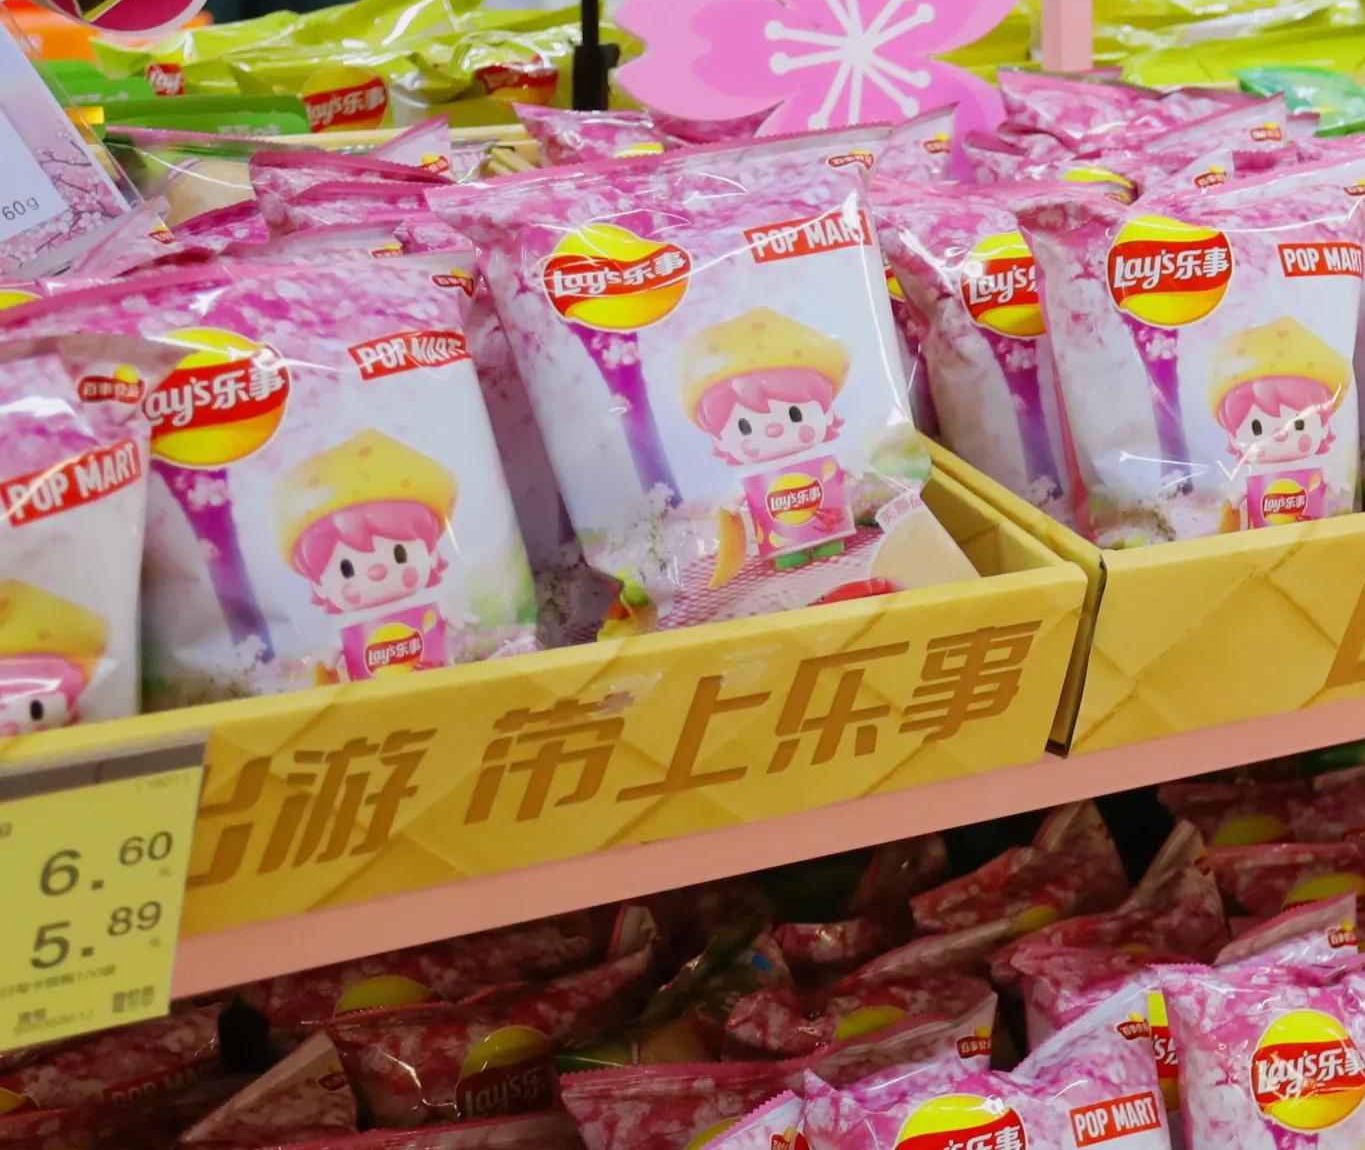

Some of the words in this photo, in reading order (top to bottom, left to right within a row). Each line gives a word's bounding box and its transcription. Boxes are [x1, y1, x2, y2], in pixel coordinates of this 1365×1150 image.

[751, 226, 799, 258] POP
[808, 212, 868, 250] MART
[1284, 249, 1320, 274] POP
[358, 347, 404, 376] POP
[411, 335, 466, 367] MART
[8, 474, 70, 523] POP
[74, 445, 139, 500] MART
[464, 618, 1043, 828] 带上乐事
[39, 830, 173, 897] 6.60
[29, 900, 163, 970] 5.89
[1074, 1111, 1110, 1141] POP
[1111, 1096, 1156, 1132] MART
